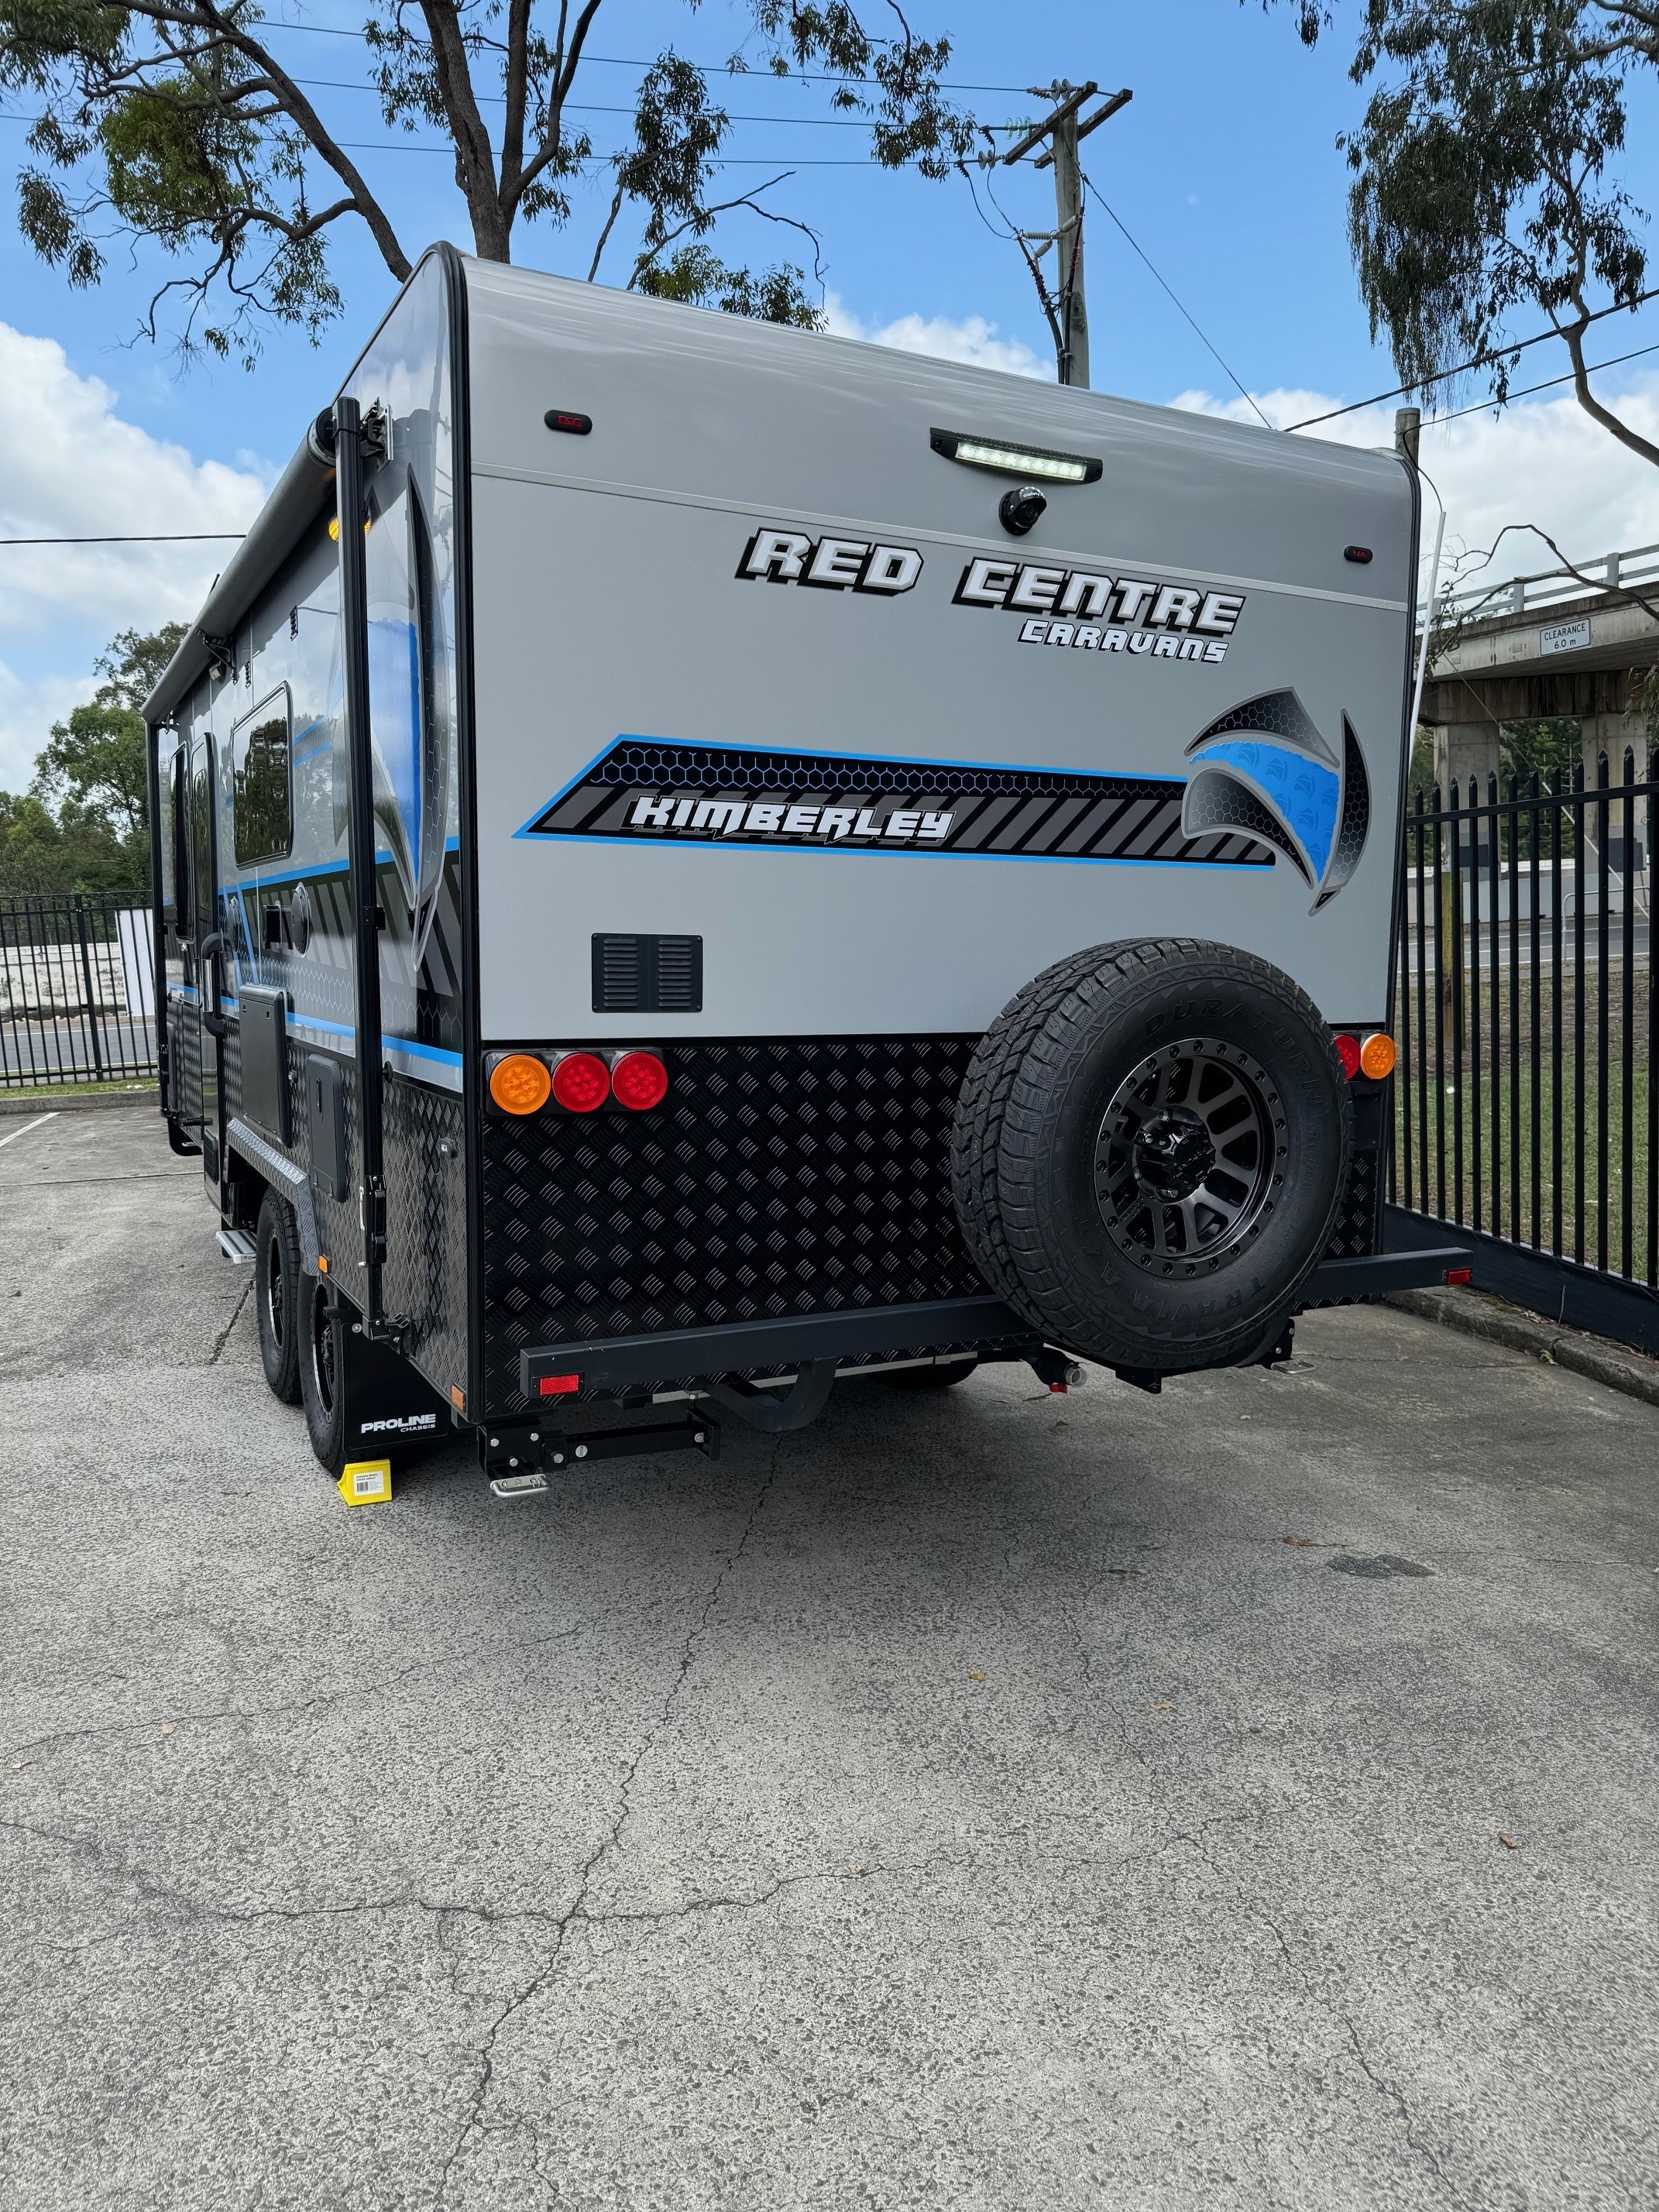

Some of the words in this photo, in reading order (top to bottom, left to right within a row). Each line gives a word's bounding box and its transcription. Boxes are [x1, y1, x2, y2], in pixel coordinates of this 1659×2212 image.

[736, 527, 923, 596] RED
[952, 557, 1245, 636] CENTRE
[1018, 619, 1229, 663] CARAVANS
[1544, 623, 1586, 641] CLEARANCE
[1554, 639, 1567, 650] 6.0
[623, 795, 957, 844] KIMBERLEY
[1145, 998, 1325, 1107] DURATURN
[361, 1413, 436, 1434] PROLINE
[400, 1423, 436, 1433] CHASSIS
